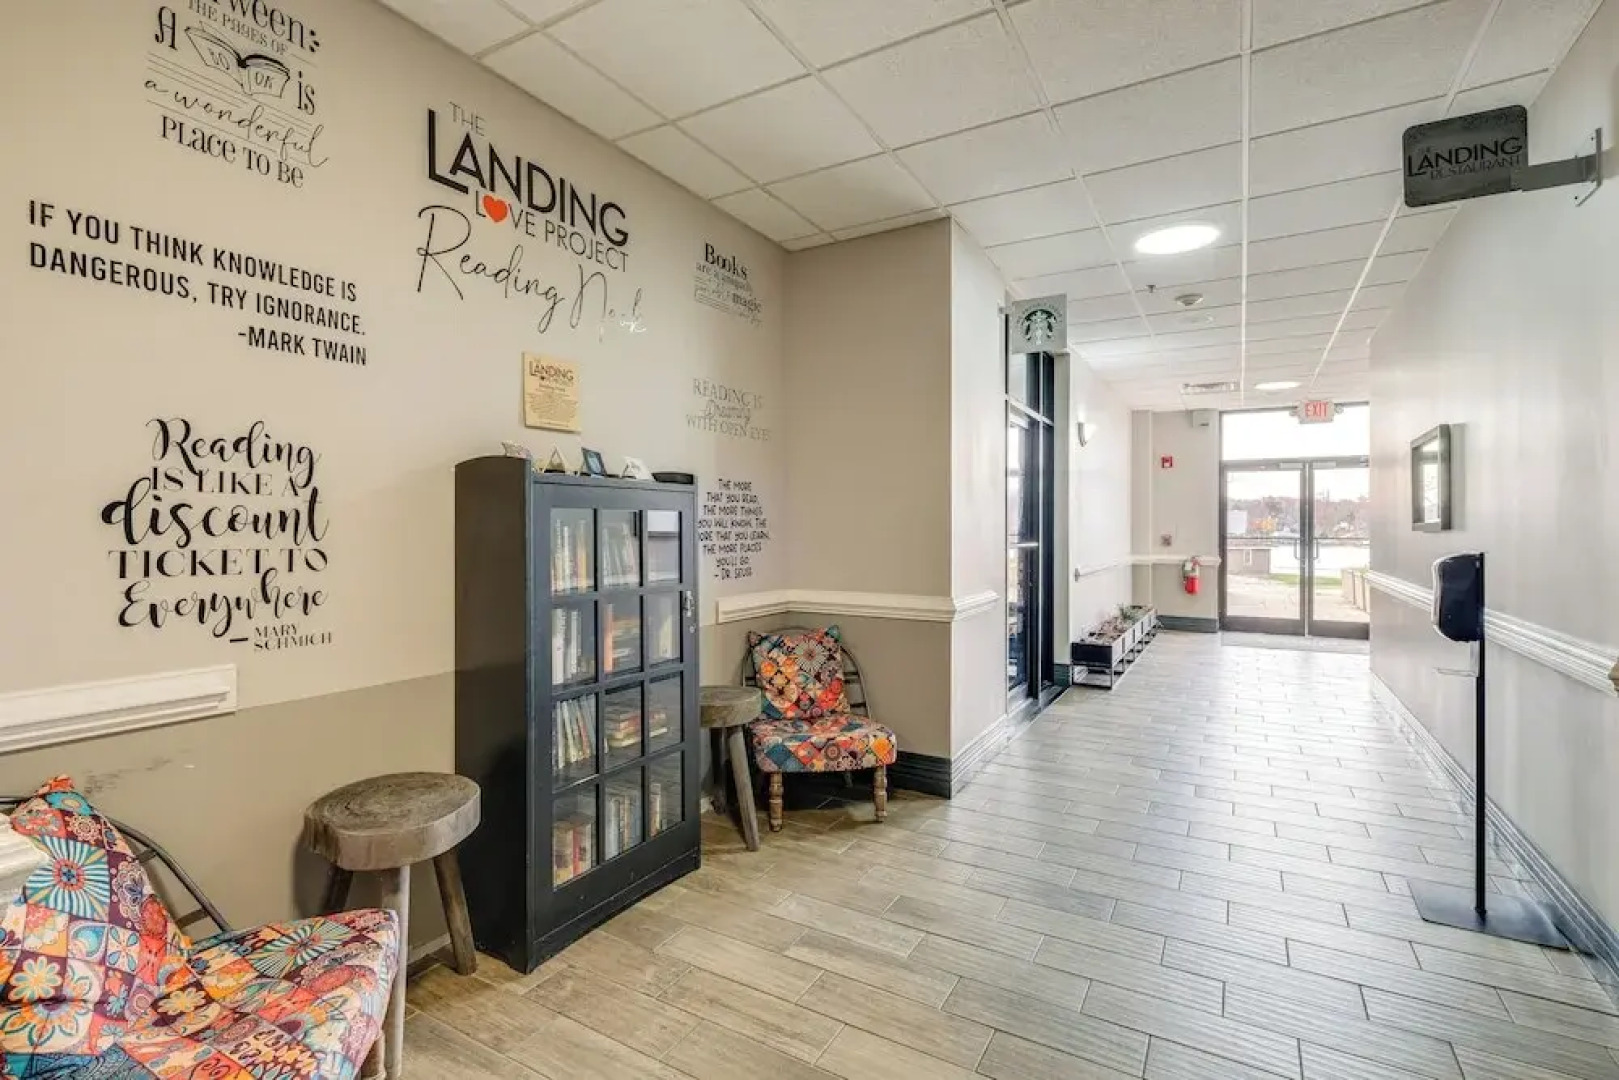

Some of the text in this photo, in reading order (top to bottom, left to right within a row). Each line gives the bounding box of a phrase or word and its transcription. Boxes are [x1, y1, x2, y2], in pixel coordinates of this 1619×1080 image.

[155, 6, 177, 50] A
[297, 70, 315, 116] is
[174, 91, 329, 167] wonderful
[449, 102, 486, 136] THE
[428, 108, 629, 247] LANDING
[1407, 137, 1522, 177] LANDING
[29, 200, 357, 302] IF YOU THINK KNOWLEDGE IS
[416, 205, 565, 334] Reading
[545, 220, 629, 272] PROJECT
[29, 242, 366, 336] DANGEROUS, TRY IGNORANCE.
[238, 326, 367, 366] -MARK TWAIN
[1305, 402, 1328, 416] EXIT
[146, 418, 322, 489] Reading
[152, 467, 299, 496] IS LIKE A
[101, 477, 329, 548] discount
[108, 548, 328, 579] TICKET TO
[118, 567, 328, 638] Everywhere
[255, 624, 297, 638] MARY
